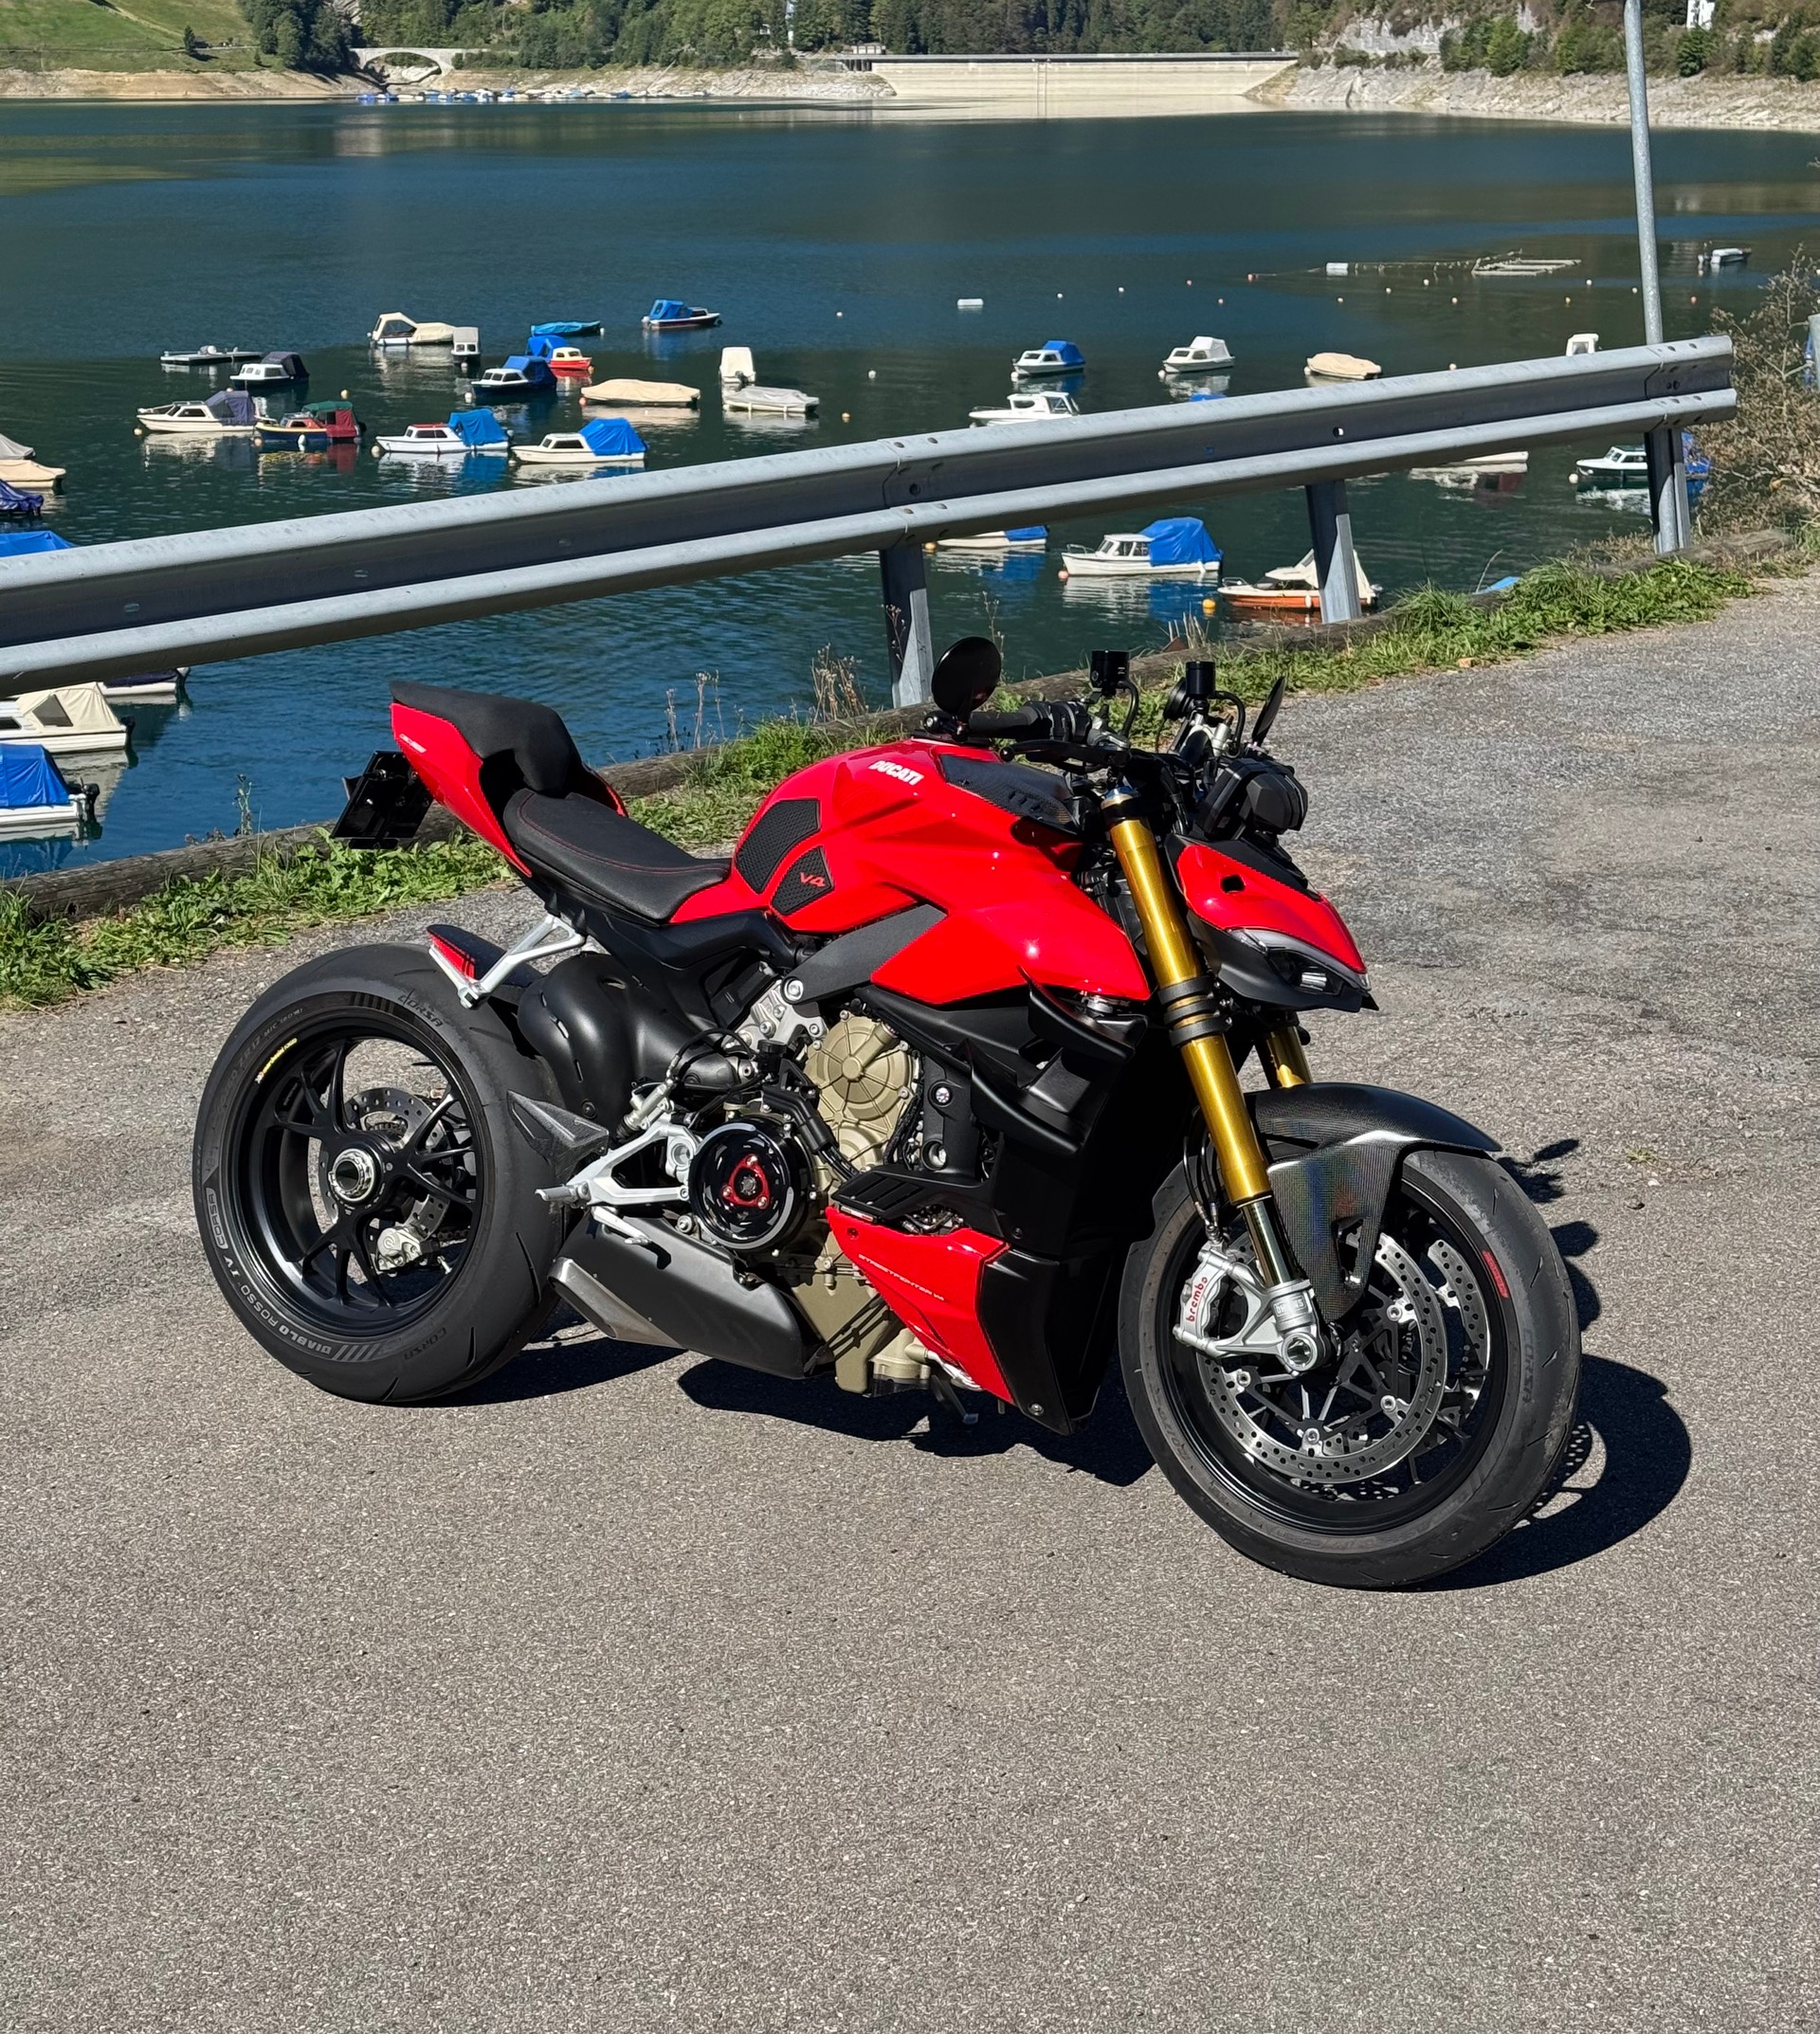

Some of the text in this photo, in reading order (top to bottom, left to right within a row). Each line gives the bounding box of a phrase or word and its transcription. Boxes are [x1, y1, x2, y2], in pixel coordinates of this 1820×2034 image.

[867, 760, 924, 786] DUCATI
[800, 872, 826, 887] V4
[397, 994, 444, 1026] CORSA
[208, 1191, 226, 1246] CORSA
[224, 1255, 332, 1354] DIABLO ROSSO IV
[1185, 1277, 1208, 1321] brembo
